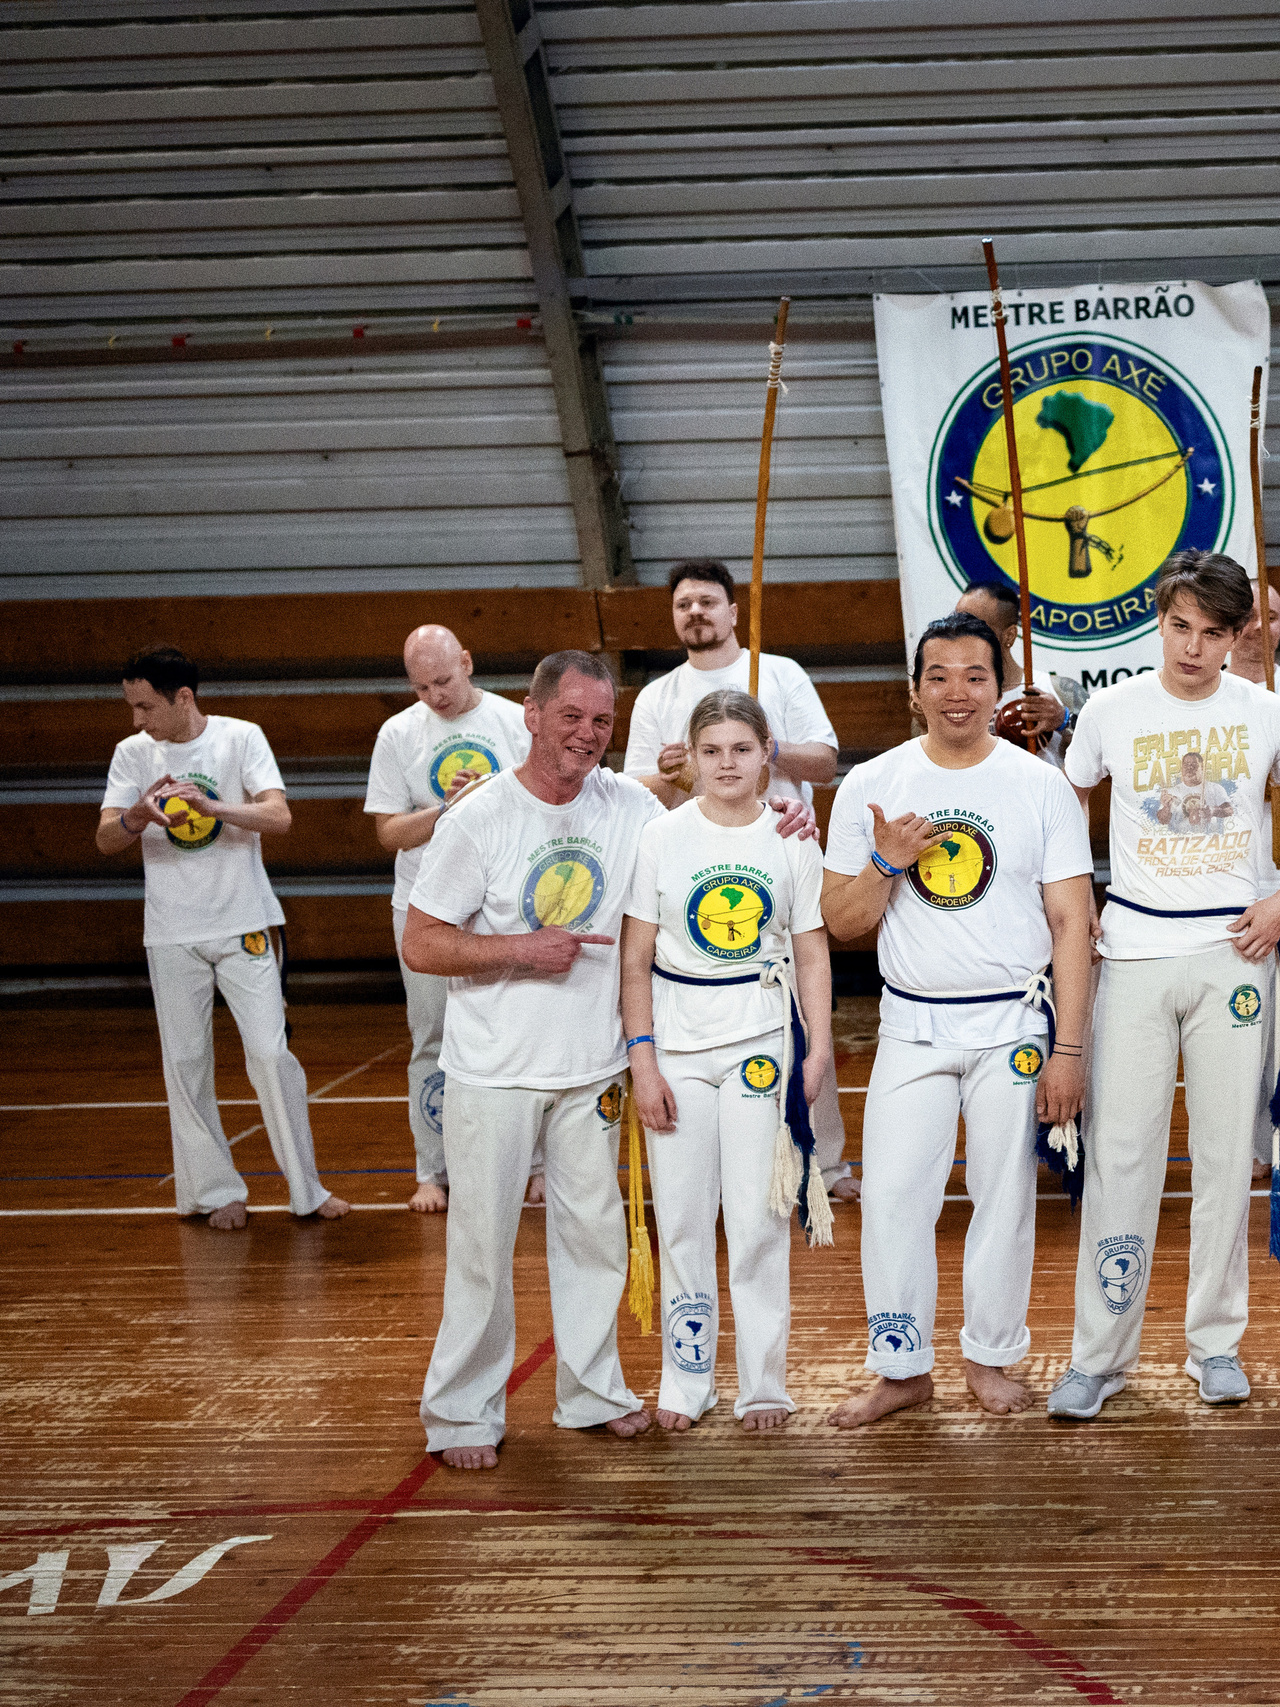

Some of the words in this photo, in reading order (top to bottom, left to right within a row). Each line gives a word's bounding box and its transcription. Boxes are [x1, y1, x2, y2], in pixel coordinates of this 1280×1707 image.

[951, 301, 1065, 329] MESTRE
[1075, 285, 1195, 322] BARRÃO
[982, 348, 1093, 410] GRUPO
[1018, 586, 1157, 633] APOEIRA
[953, 808, 995, 833] BARRÃO
[527, 837, 563, 863] MESTRE
[1137, 829, 1252, 855] BATIZADO
[538, 851, 571, 871] GRUPO
[1180, 854, 1199, 866] DE
[690, 864, 731, 882] MESTRE
[734, 864, 774, 885] BARRÃO
[702, 876, 739, 892] GRUPO
[930, 894, 974, 907] CAPOEIRA
[706, 945, 757, 958] CAPOEIRA
[1103, 1244, 1130, 1257] GRUPO
[873, 1322, 898, 1334] GRUPO
